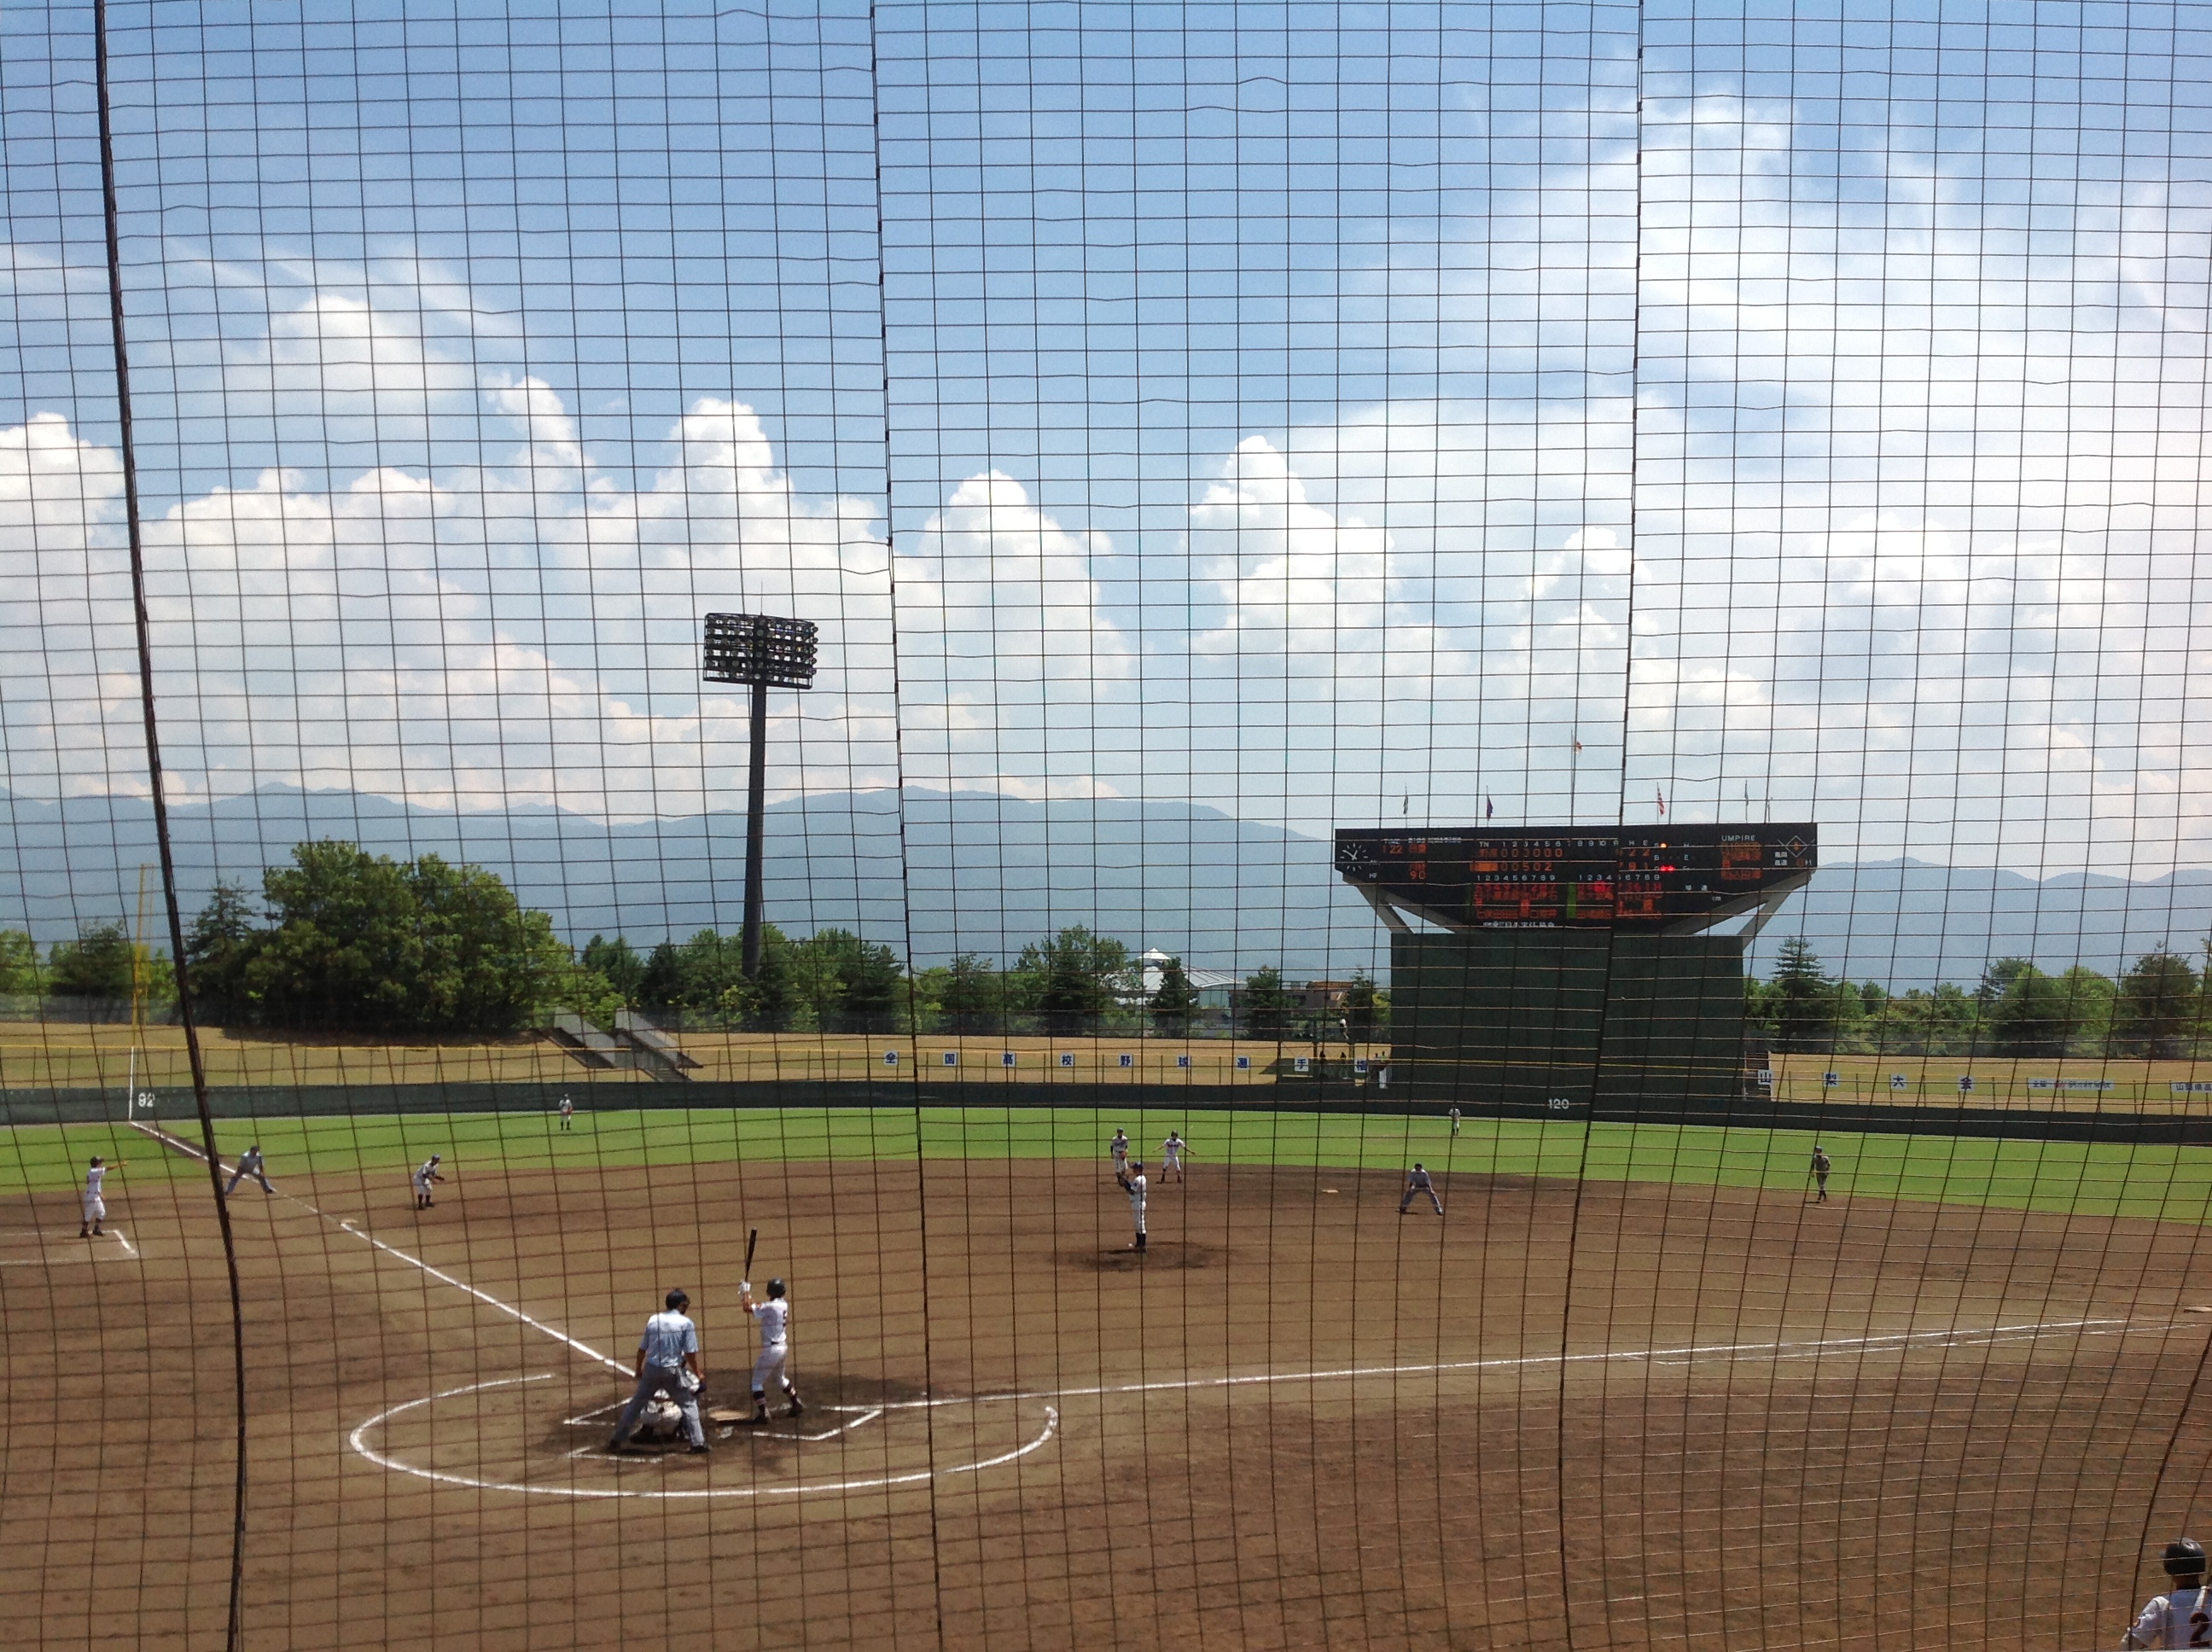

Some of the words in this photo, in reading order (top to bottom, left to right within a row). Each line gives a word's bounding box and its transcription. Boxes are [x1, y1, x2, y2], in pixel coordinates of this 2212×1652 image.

[885, 1052, 896, 1064] 全
[945, 1053, 955, 1064] 国
[1003, 1053, 1014, 1065] 高
[1062, 1054, 1072, 1066] 校
[1121, 1055, 1131, 1066] 野
[1296, 1058, 1307, 1069] 手
[1760, 1071, 1772, 1083] 山
[1892, 1075, 1904, 1087] 大
[138, 1092, 155, 1108] 92
[1548, 1098, 1569, 1109] 120
